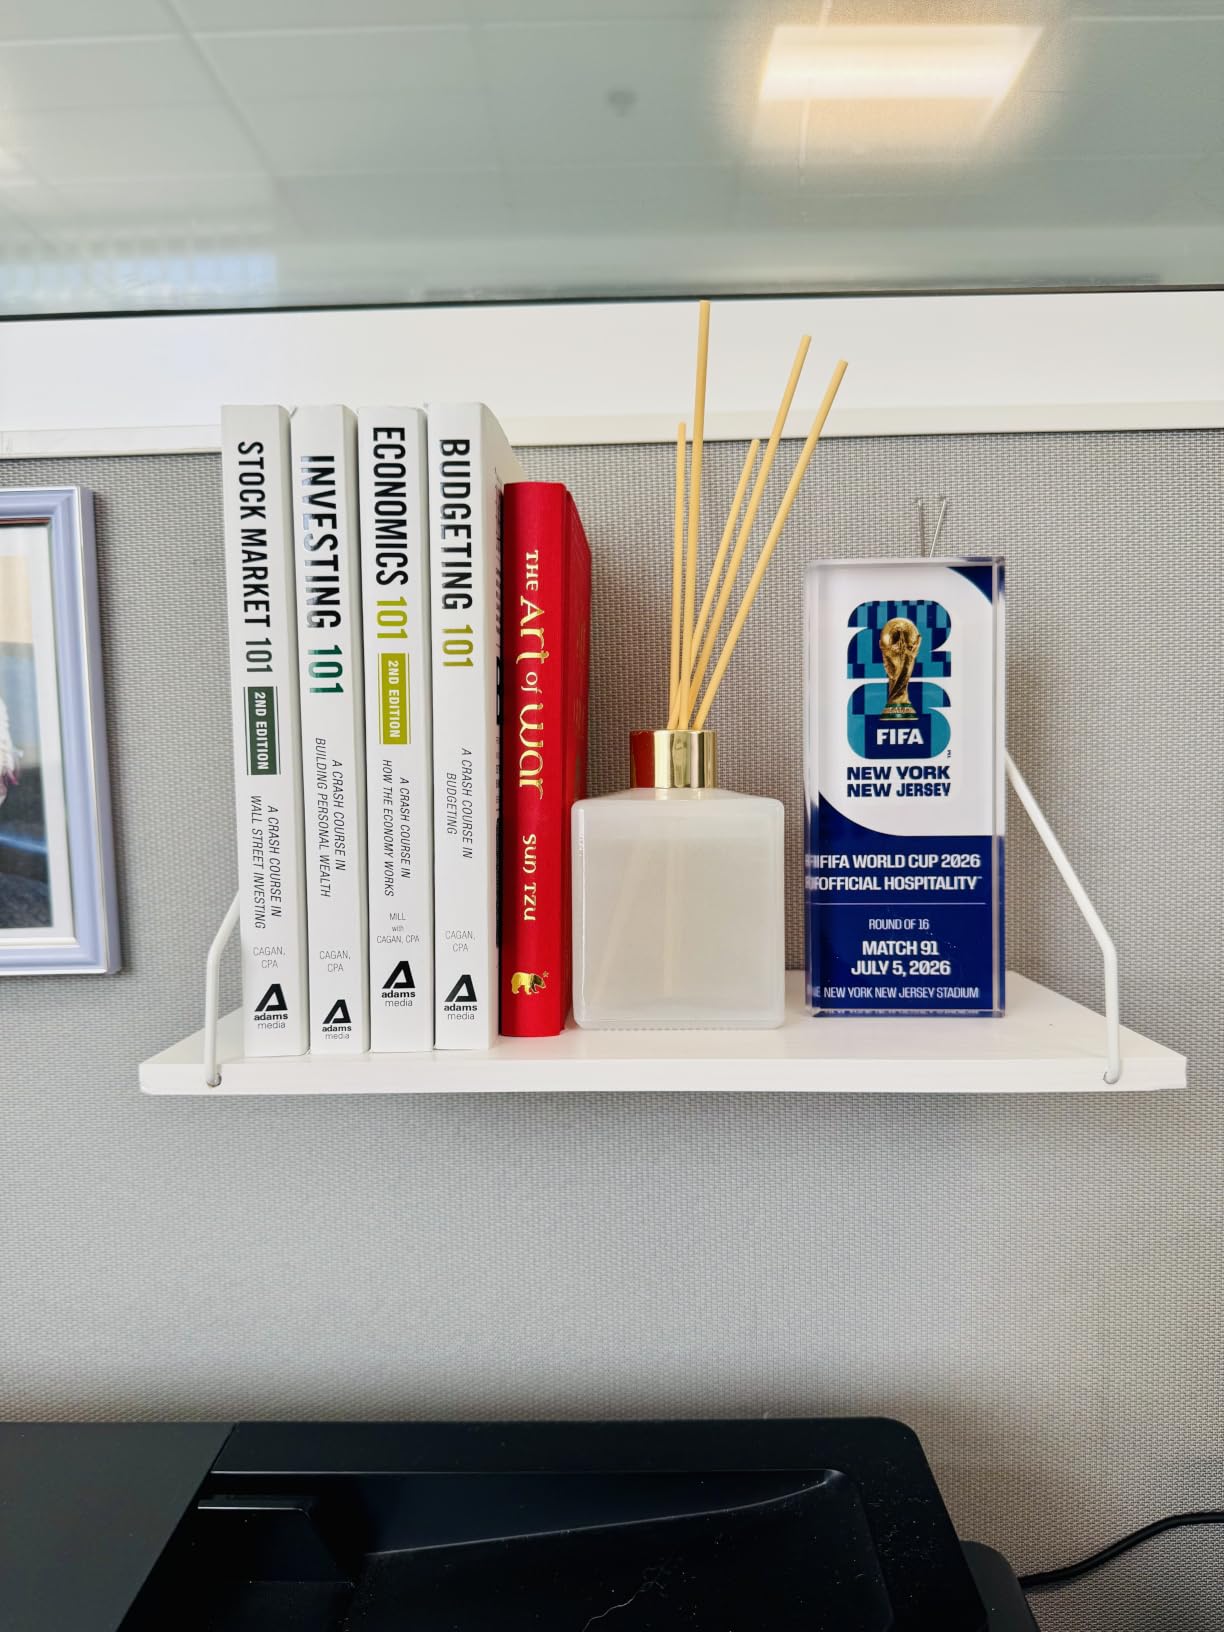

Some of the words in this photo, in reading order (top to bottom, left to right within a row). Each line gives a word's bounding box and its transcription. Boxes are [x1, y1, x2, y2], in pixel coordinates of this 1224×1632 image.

[237, 441, 267, 520] STOCK
[373, 427, 408, 586] ECONOMICS
[439, 439, 473, 610] BUDGETING
[301, 456, 342, 629] INVESTING
[240, 528, 271, 628] MARKET
[376, 596, 408, 639] 101
[246, 637, 274, 673] 101
[442, 624, 474, 667] 101
[307, 645, 344, 694] 101
[388, 660, 400, 684] 2ND
[521, 672, 542, 694] of
[254, 692, 267, 716] 2ND
[388, 689, 400, 738] EDITION
[255, 721, 270, 770] EDITION
[876, 728, 924, 745] FIFA
[315, 737, 328, 790] BUILDING
[462, 748, 472, 756] A
[382, 759, 392, 784] HOW
[461, 760, 472, 796] CRASH
[847, 766, 892, 780] NEW
[896, 765, 950, 780] YORK
[332, 770, 344, 808] CRASH
[384, 786, 393, 805] THE
[847, 783, 892, 798] NEW
[896, 782, 951, 797] JERSEY
[250, 795, 262, 824] WALL
[268, 805, 279, 813] A
[400, 788, 410, 822] CRASH
[447, 773, 458, 835] BUDGETING
[317, 793, 330, 850] PERSONAL
[384, 808, 394, 858] ECONOMY
[462, 799, 473, 844] COURSE
[268, 816, 280, 855] CRASH
[334, 811, 346, 857] COURSE
[400, 824, 410, 865] COURSE
[252, 828, 264, 869] STREET
[463, 847, 473, 858] IN
[335, 859, 346, 871] IN
[401, 868, 411, 878] IN
[820, 855, 850, 868] FIFA
[852, 854, 906, 868] WORLD
[908, 854, 938, 868] CUP
[941, 854, 980, 868] 2026
[270, 857, 282, 902] COURSE
[319, 854, 331, 898] WEALTH
[384, 861, 394, 897] WORKS
[818, 876, 881, 890] OFFICIAL
[253, 872, 266, 929] INVESTING
[271, 904, 282, 917] IN
[869, 919, 902, 930] ROUND
[904, 919, 917, 930] OF
[918, 919, 930, 930] 16
[452, 943, 468, 952] CPA
[862, 941, 917, 956] MATCH
[920, 941, 940, 956] 91
[261, 960, 278, 969] CPA
[327, 964, 344, 972] CPA
[851, 960, 889, 975] JULY
[892, 960, 907, 977] 5,
[909, 960, 951, 975] 2026
[381, 990, 416, 998] adams
[385, 999, 413, 1007] media
[824, 987, 846, 998] NEW
[847, 987, 873, 998] YORK
[874, 987, 897, 998] NEW
[898, 987, 935, 998] JERSEY
[936, 987, 979, 998] STADIUM
[254, 1013, 288, 1021] adams
[443, 1004, 478, 1012] adams
[447, 1012, 475, 1020] media
[258, 1021, 286, 1030] media
[325, 1032, 350, 1040] media
